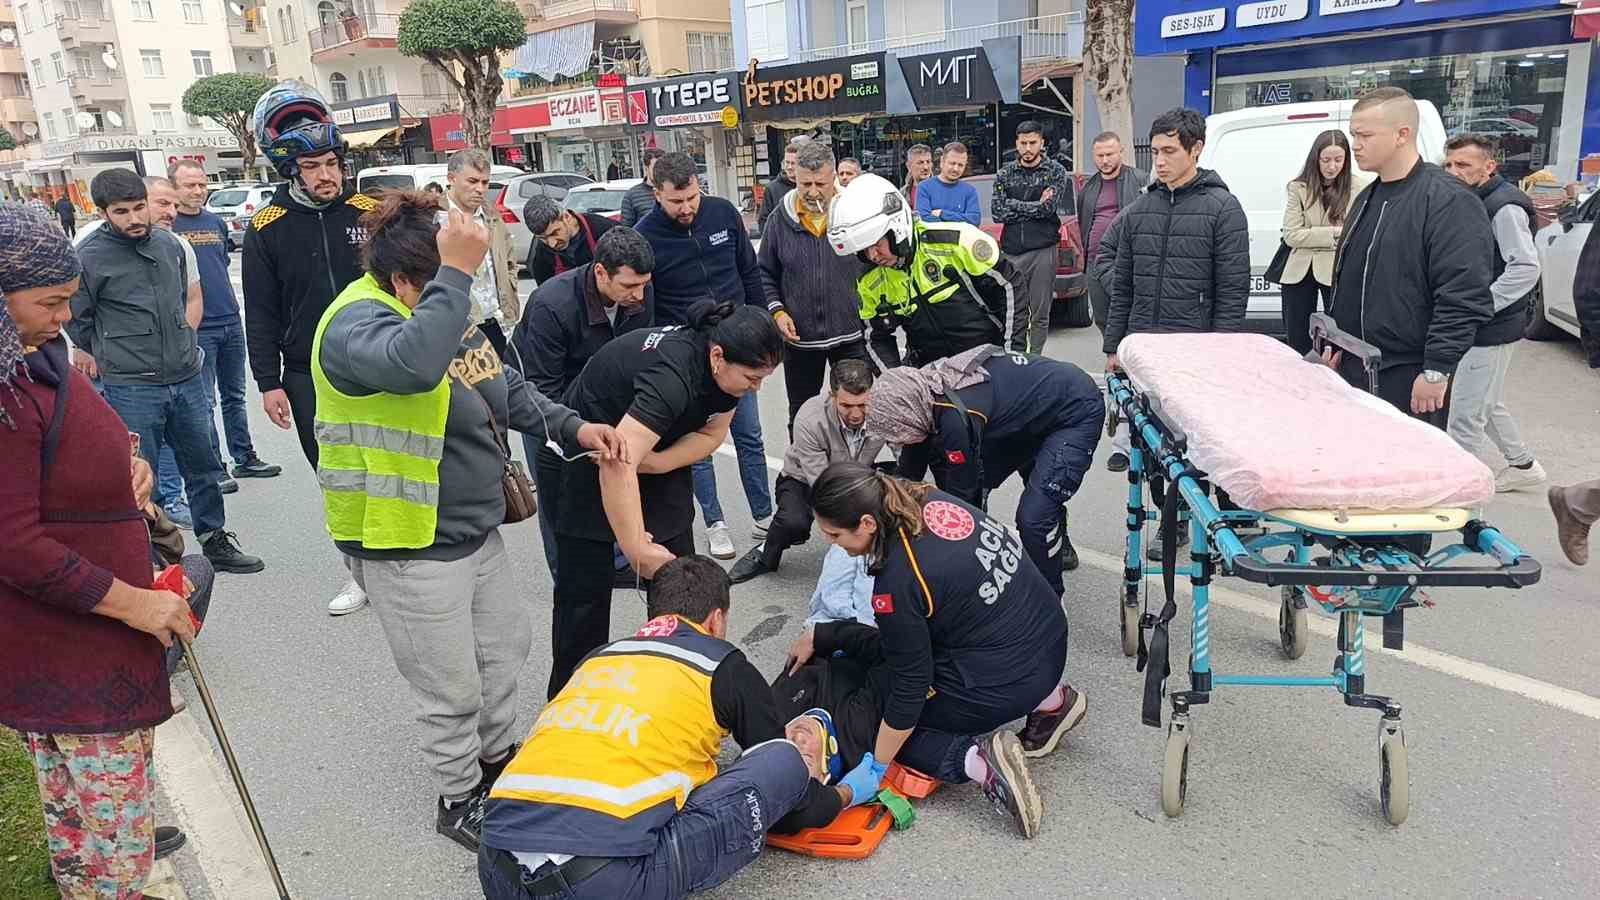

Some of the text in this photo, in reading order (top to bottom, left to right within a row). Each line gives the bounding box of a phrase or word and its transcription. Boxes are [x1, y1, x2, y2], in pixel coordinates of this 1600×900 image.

[1256, 4, 1287, 20] UYDU
[1170, 14, 1215, 31] SES-IŞIK
[744, 73, 843, 107] PETSHOP
[846, 83, 879, 97] BUĞRA
[551, 94, 597, 117] ECZANE
[154, 135, 238, 148] PASTANES
[541, 695, 651, 749] AĞLIK
